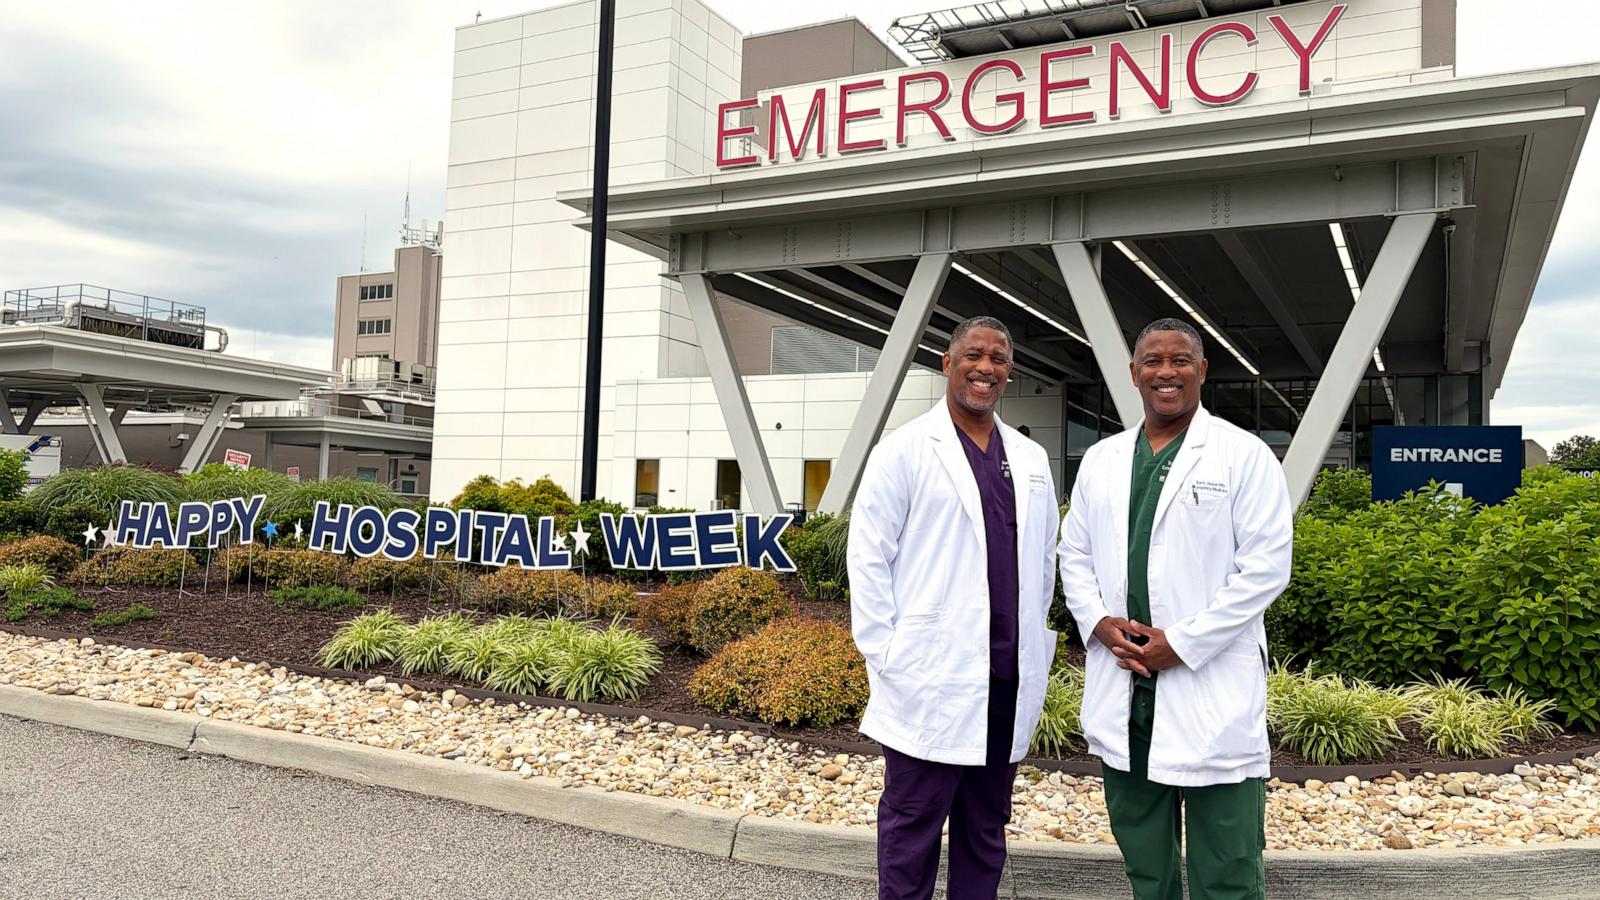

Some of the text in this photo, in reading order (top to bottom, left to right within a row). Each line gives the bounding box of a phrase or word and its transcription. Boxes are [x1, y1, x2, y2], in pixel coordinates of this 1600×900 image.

[716, 4, 1347, 169] EMERGENCY
[1390, 447, 1503, 463] ENTRANCE
[115, 494, 798, 572] HAPPY HOSPITAL WEEK
